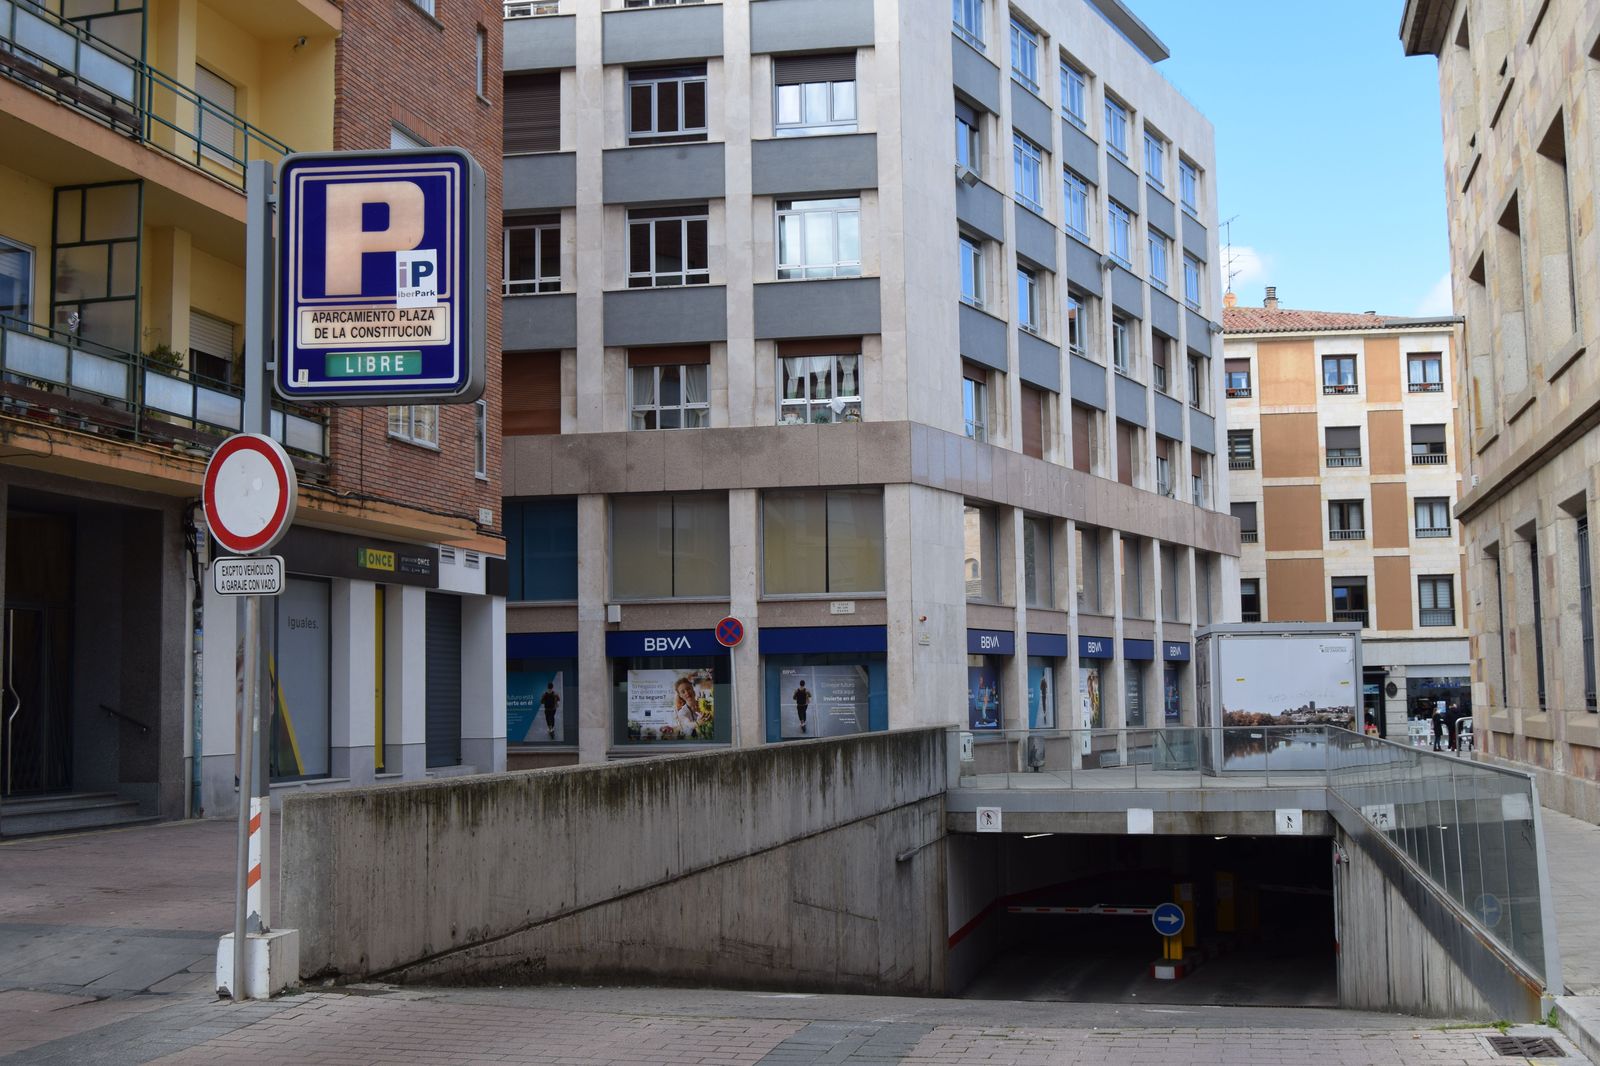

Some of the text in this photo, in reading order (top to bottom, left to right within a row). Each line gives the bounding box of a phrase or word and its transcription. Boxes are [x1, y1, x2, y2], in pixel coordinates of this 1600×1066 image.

[325, 181, 425, 296] P
[311, 309, 435, 324] APARCAMIENTO PLAZA
[314, 325, 432, 340] DE LA CONSTITUCION
[345, 355, 404, 373] LIBRE
[368, 553, 392, 567] ONCE
[243, 561, 274, 576] VEHÍCULOS
[221, 579, 276, 591] A GARAJE CON VADO
[644, 635, 691, 652] BBVA
[981, 635, 999, 649] BBVA
[1087, 641, 1102, 653] BBVA
[1170, 646, 1182, 657] BBVA
